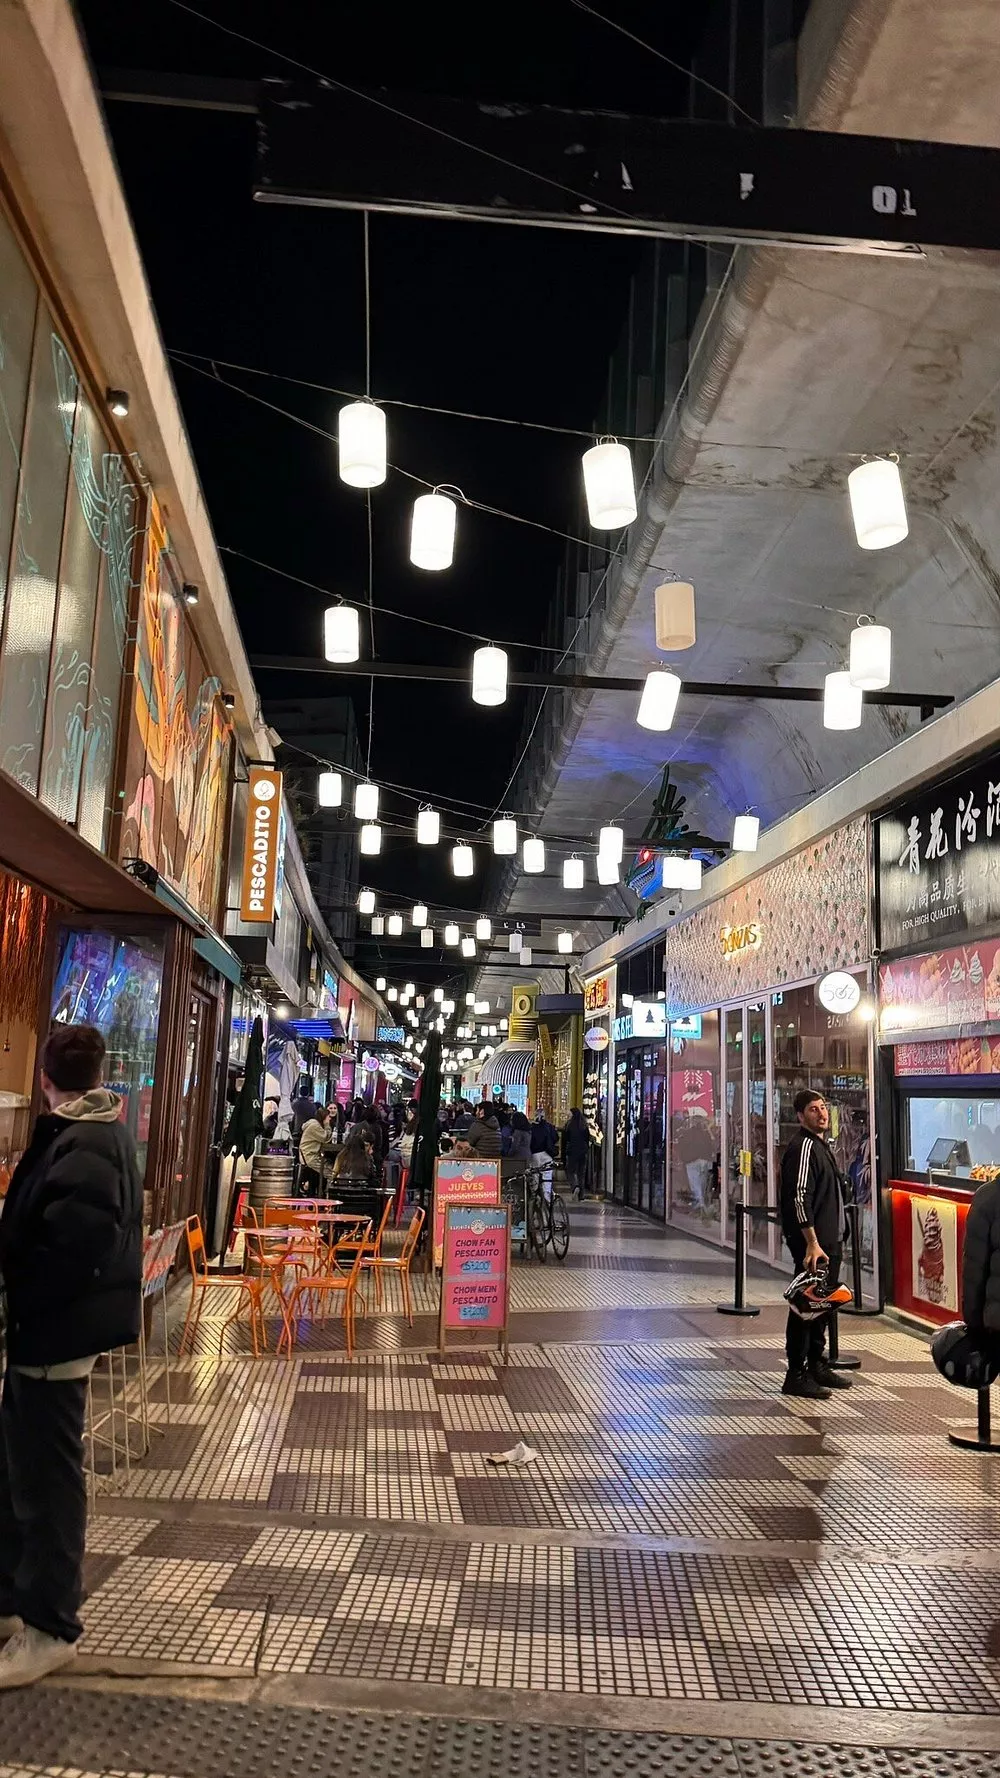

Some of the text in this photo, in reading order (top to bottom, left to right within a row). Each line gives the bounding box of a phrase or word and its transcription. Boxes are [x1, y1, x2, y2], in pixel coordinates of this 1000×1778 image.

[249, 805, 271, 912] PESCADITO
[902, 918, 914, 931] FOR
[914, 912, 930, 928] HIGH
[448, 1182, 485, 1192] JUEVES
[479, 1239, 496, 1247] FAN
[454, 1249, 500, 1258] PESCADITO
[453, 1285, 497, 1294] CHOW MEIN
[452, 1296, 498, 1305] PESCADITO
